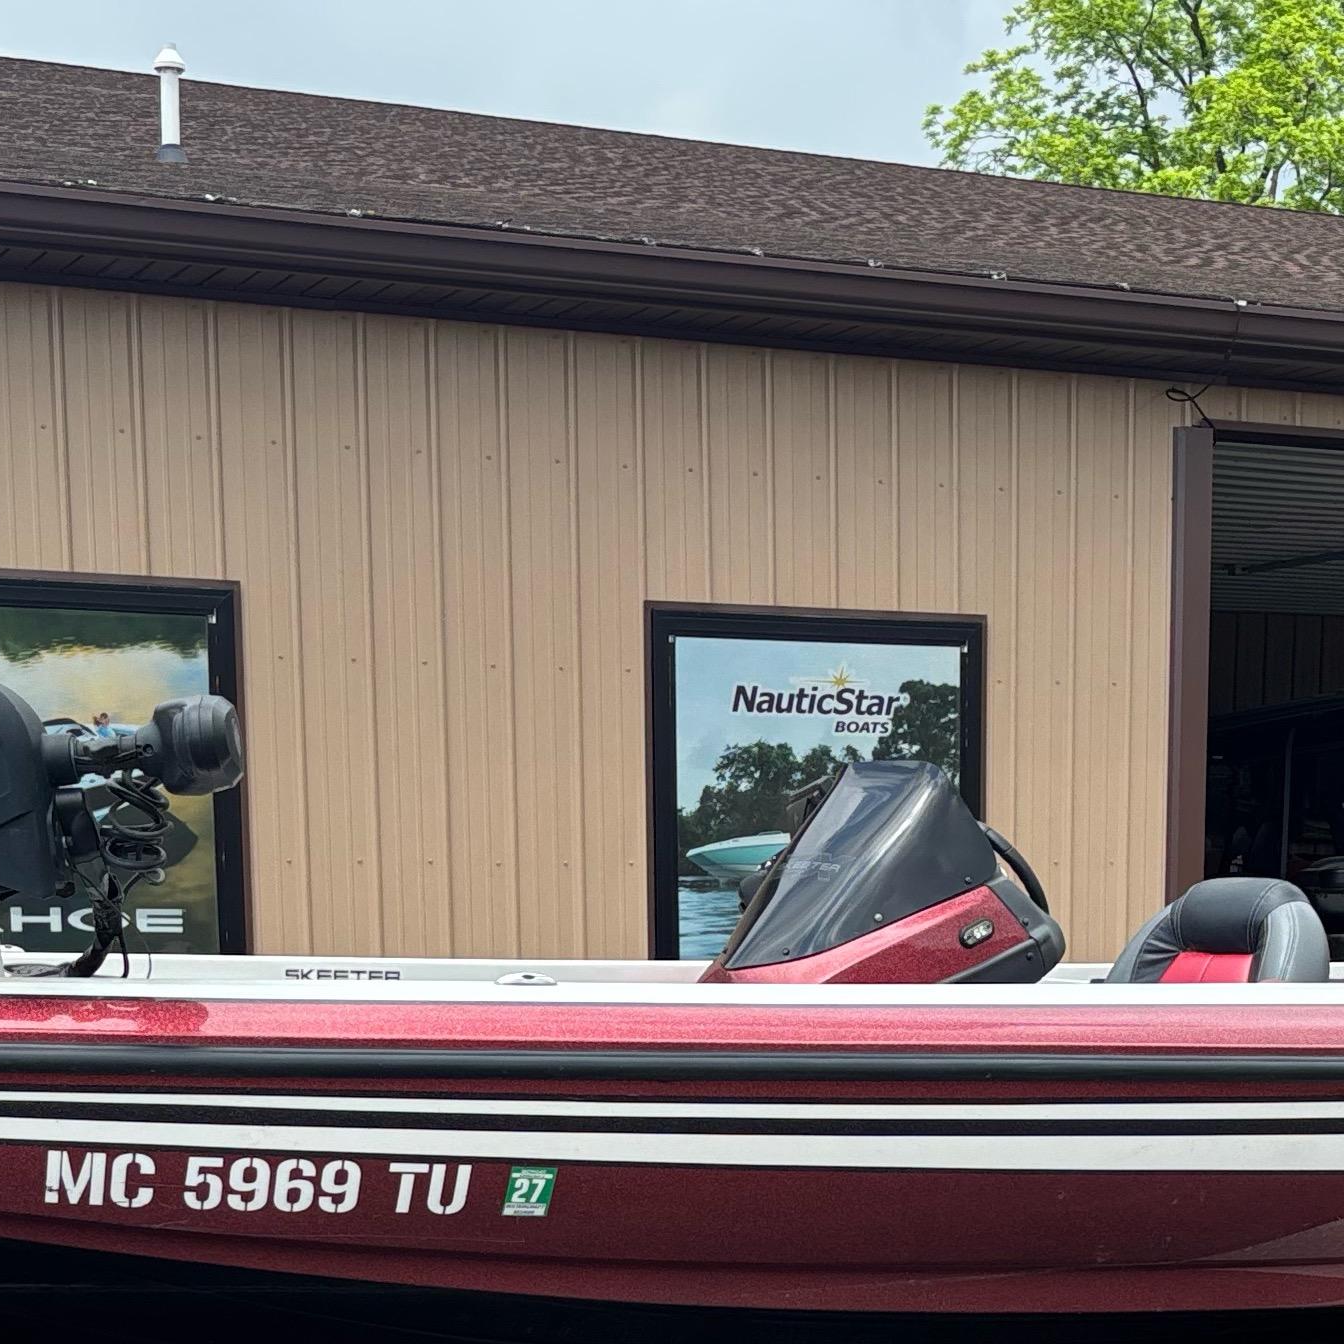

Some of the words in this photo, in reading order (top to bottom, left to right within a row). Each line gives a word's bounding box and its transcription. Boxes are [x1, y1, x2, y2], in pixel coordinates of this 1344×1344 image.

[732, 684, 901, 716] NauticStar
[834, 720, 890, 734] BOATS
[44, 1149, 155, 1209] MC
[183, 1156, 361, 1213] 5969
[388, 1162, 473, 1215] TU
[511, 1178, 546, 1203] 27
